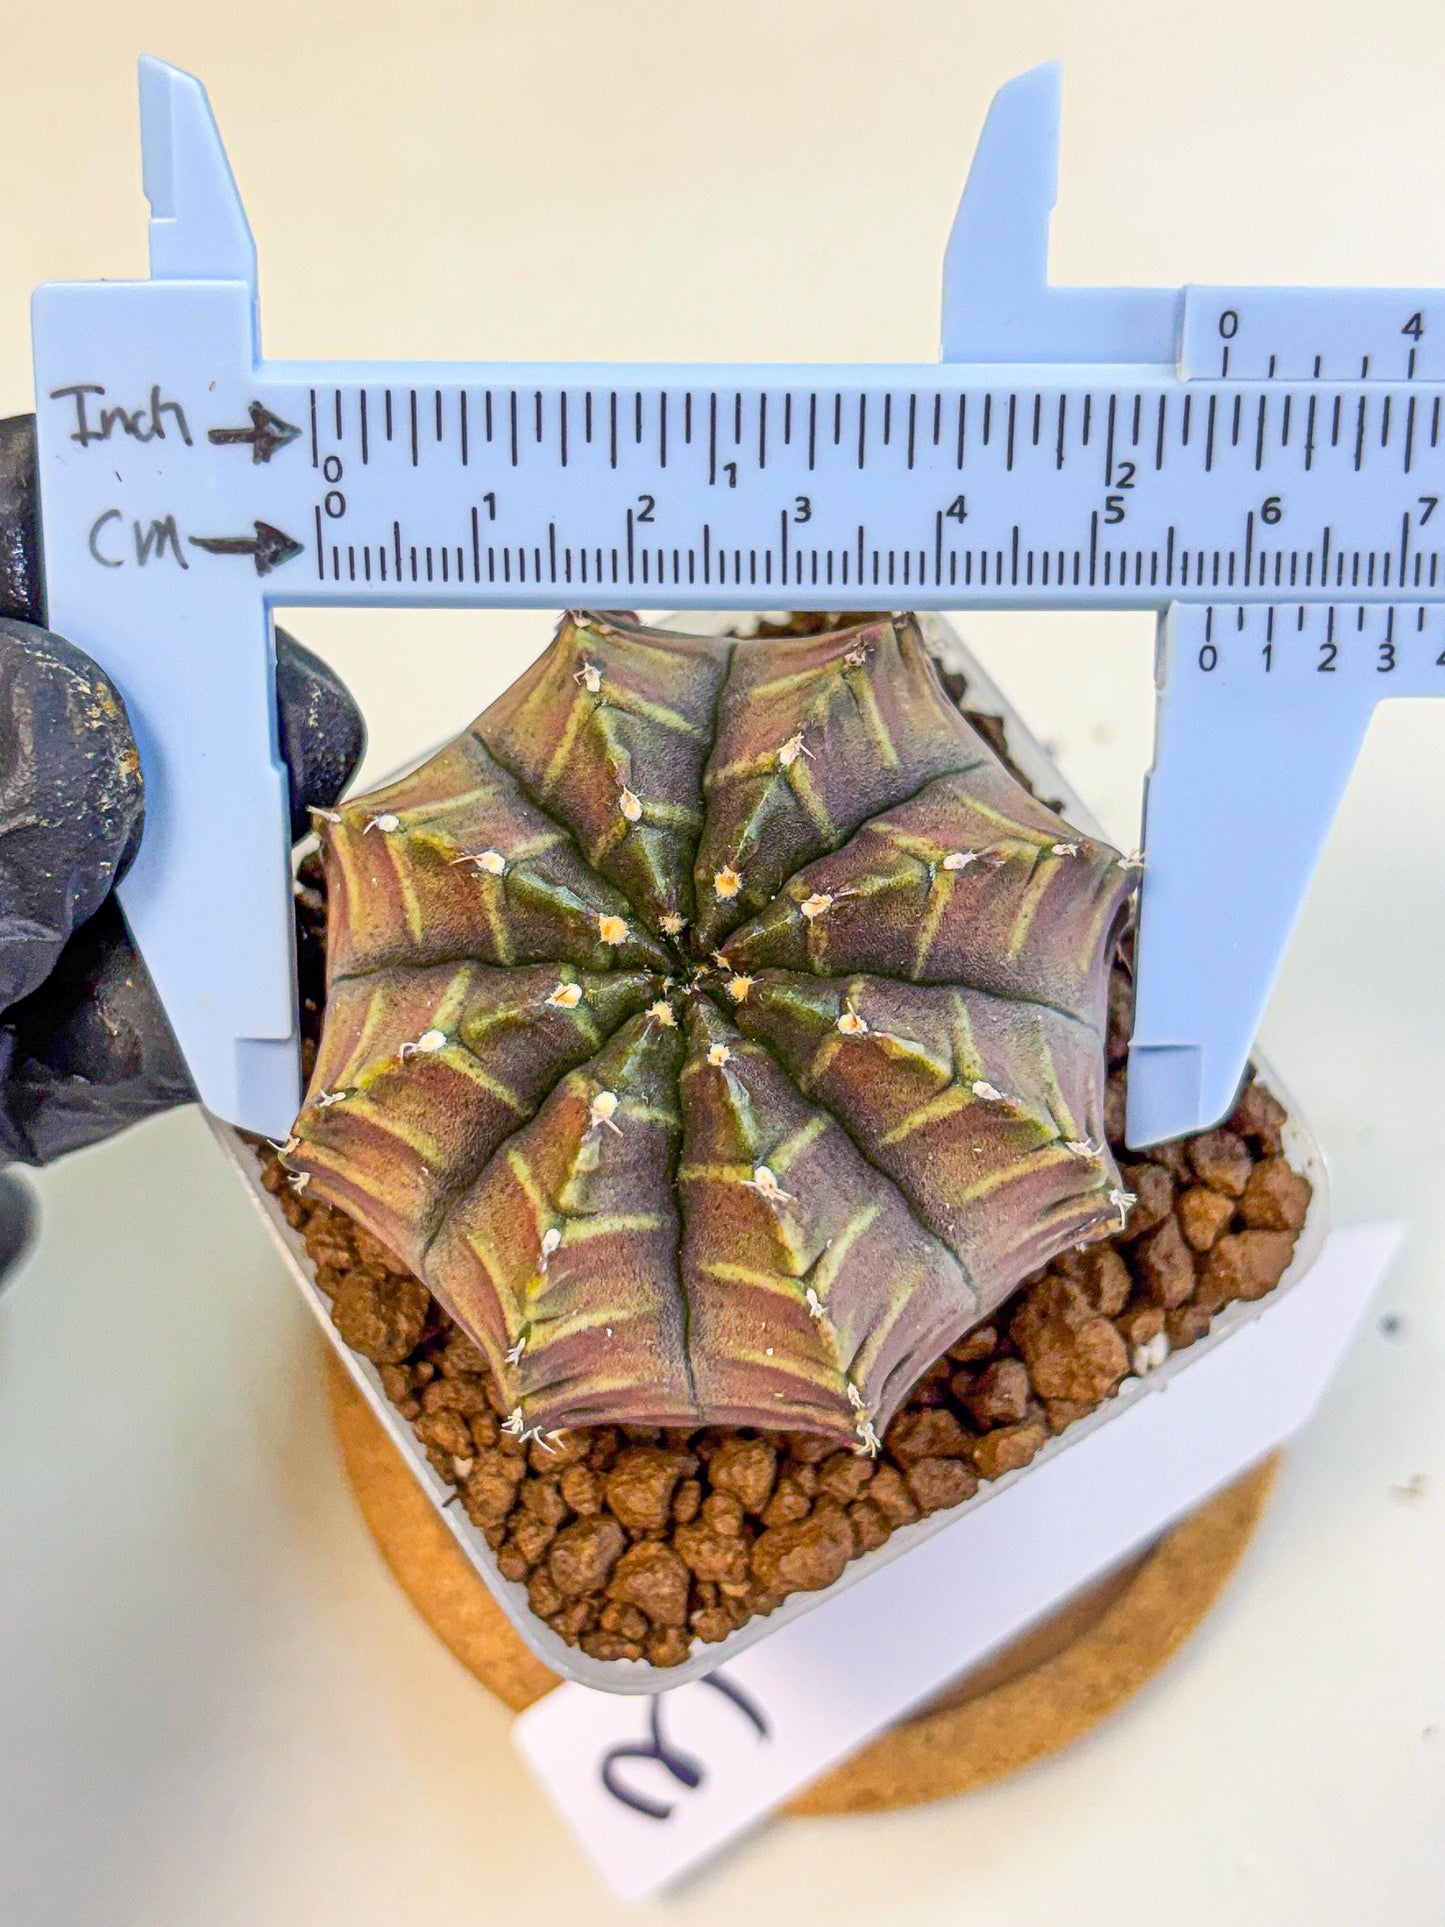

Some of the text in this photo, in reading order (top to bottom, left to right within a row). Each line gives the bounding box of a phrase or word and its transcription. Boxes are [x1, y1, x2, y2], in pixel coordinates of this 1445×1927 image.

[1218, 310, 1424, 341] 0 4
[50, 384, 194, 449] Inch
[322, 455, 1136, 490] 0 1 2
[324, 490, 1439, 527] 0 1 2 3 4 5 6 7
[1198, 643, 1396, 673] 0 1 2 3
